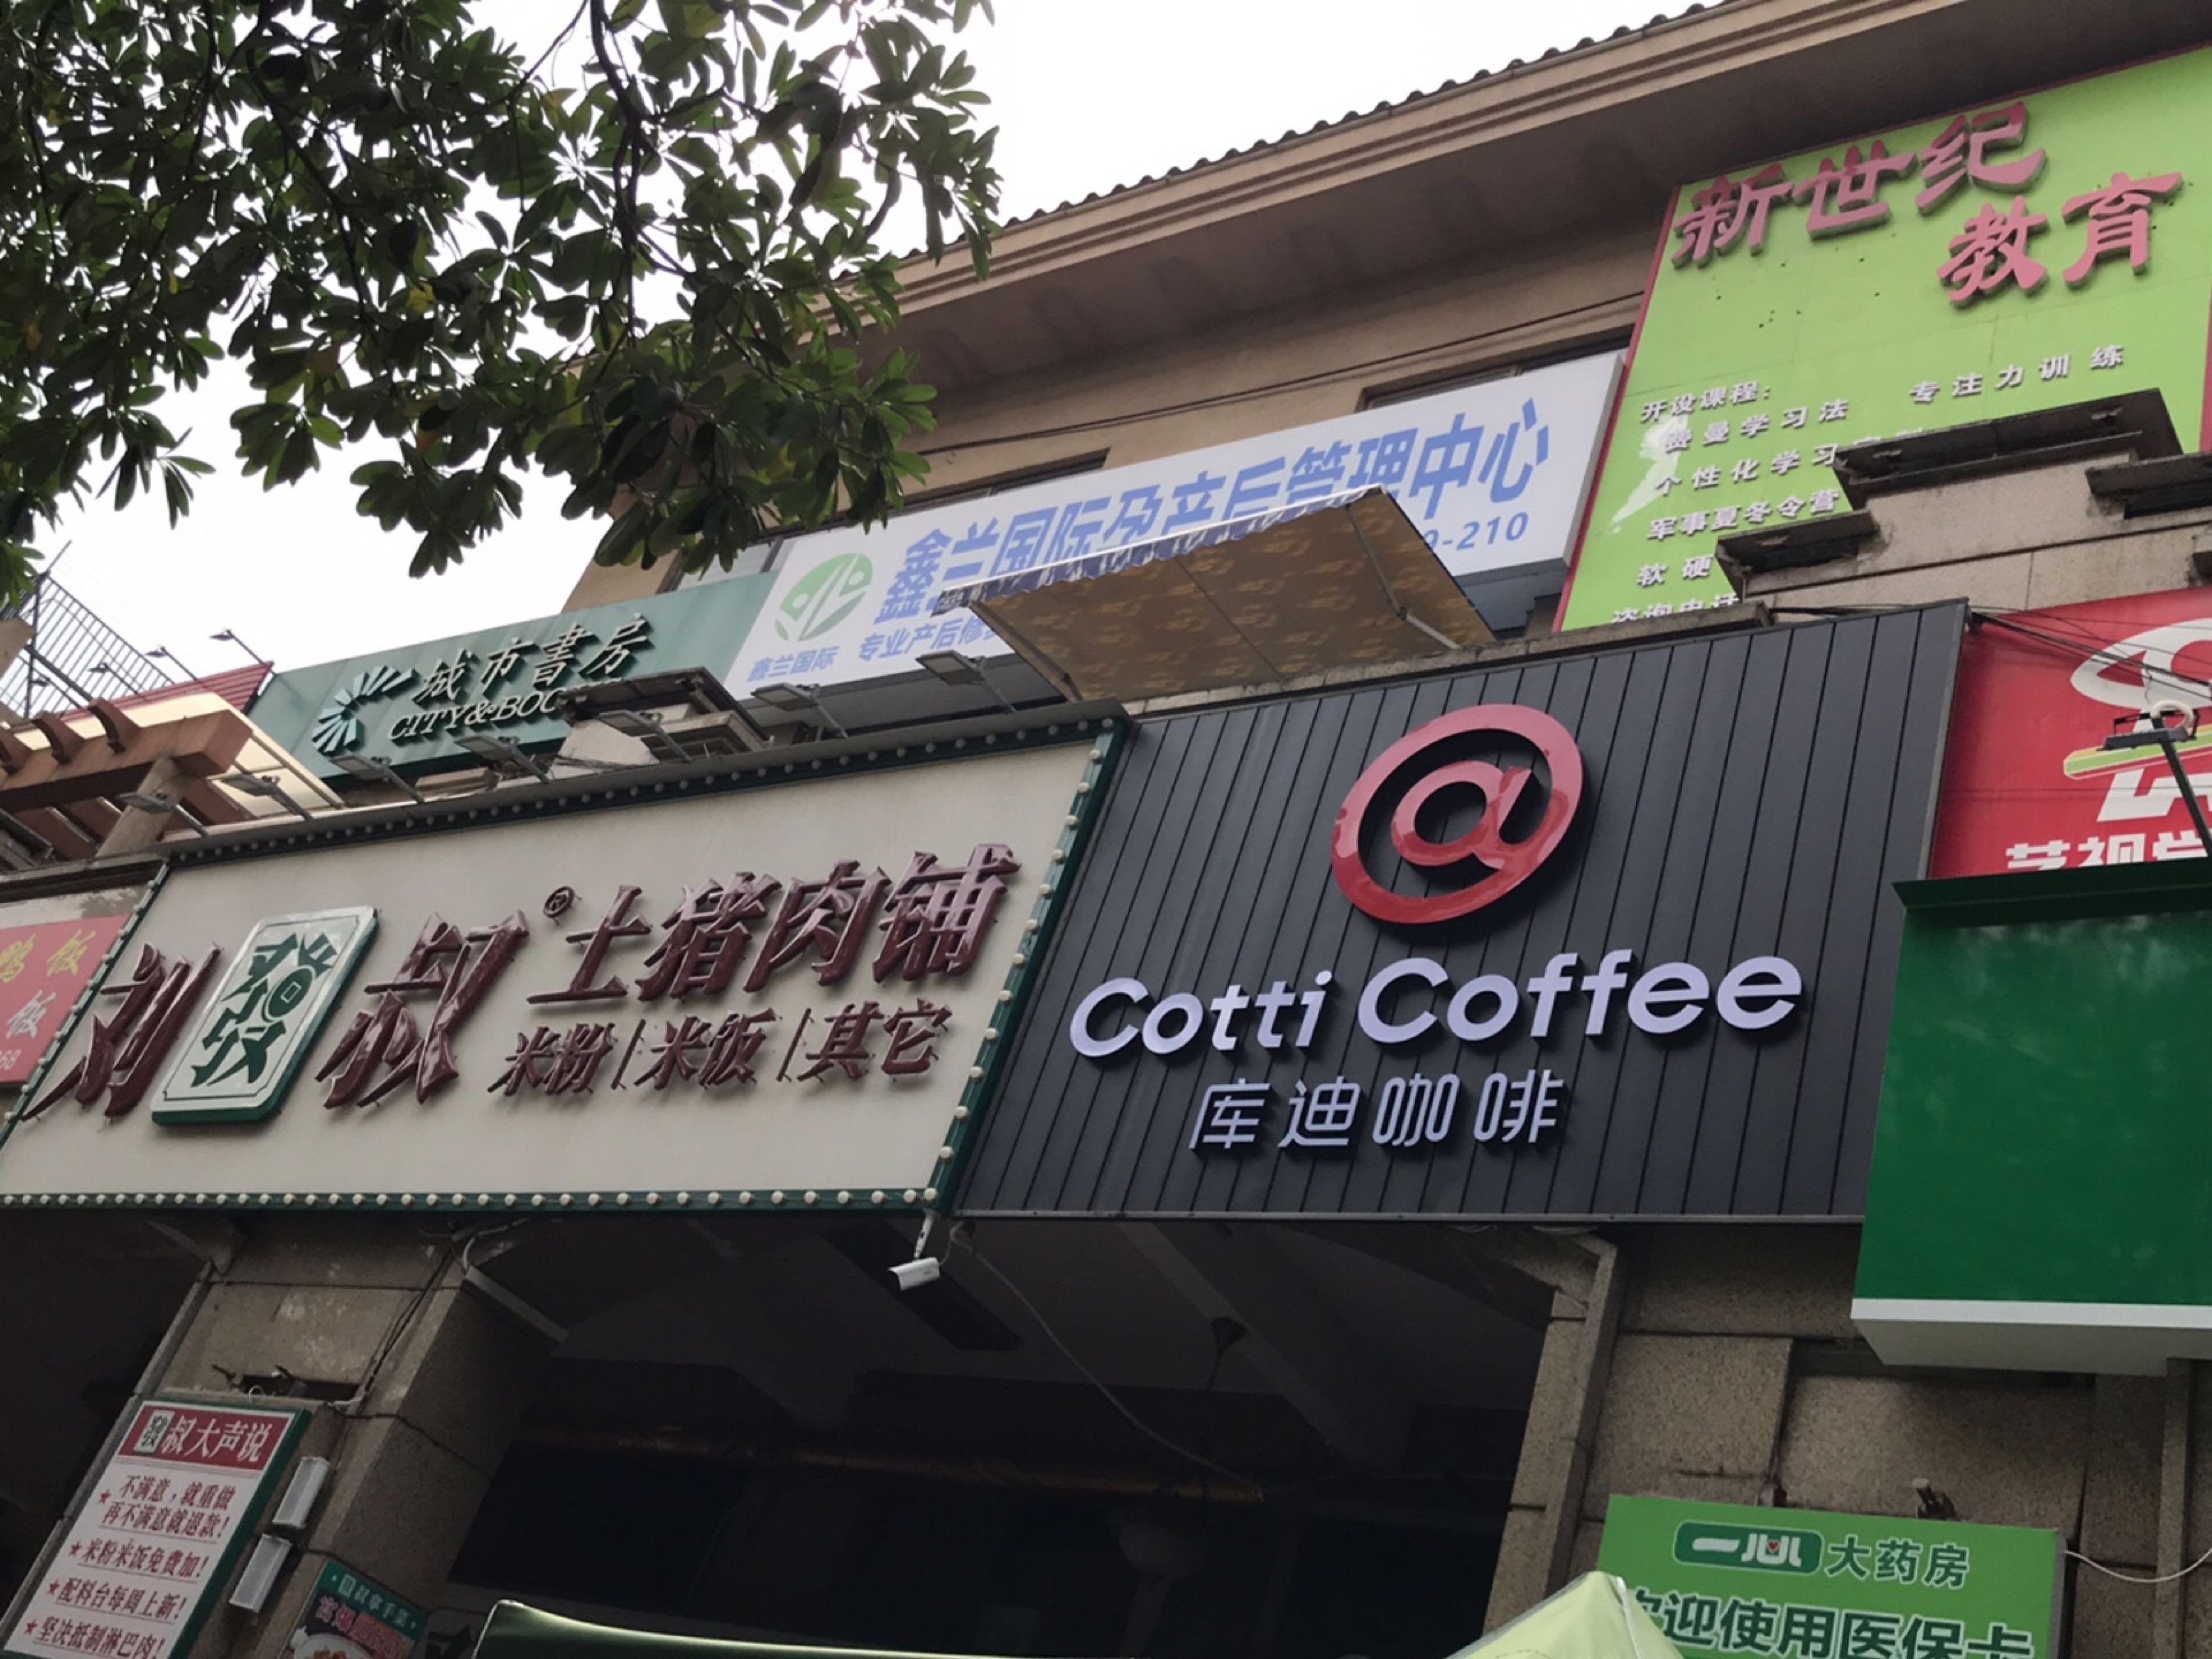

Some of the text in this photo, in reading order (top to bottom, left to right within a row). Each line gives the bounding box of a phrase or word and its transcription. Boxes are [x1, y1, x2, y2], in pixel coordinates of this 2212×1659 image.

[1671, 100, 2046, 268] 新世纪
[1937, 171, 2183, 307] 教育
[1909, 344, 2124, 404] 专注力训练
[746, 646, 840, 682] 鑫兰国际
[526, 843, 1020, 1005] 土猪肉铺
[488, 998, 952, 1096] 米粉 米饭 其它
[1070, 949, 1802, 1057] Cotti Coffee
[1190, 1069, 1564, 1150] 库迪咖啡
[1826, 1535, 1969, 1588] 大药房
